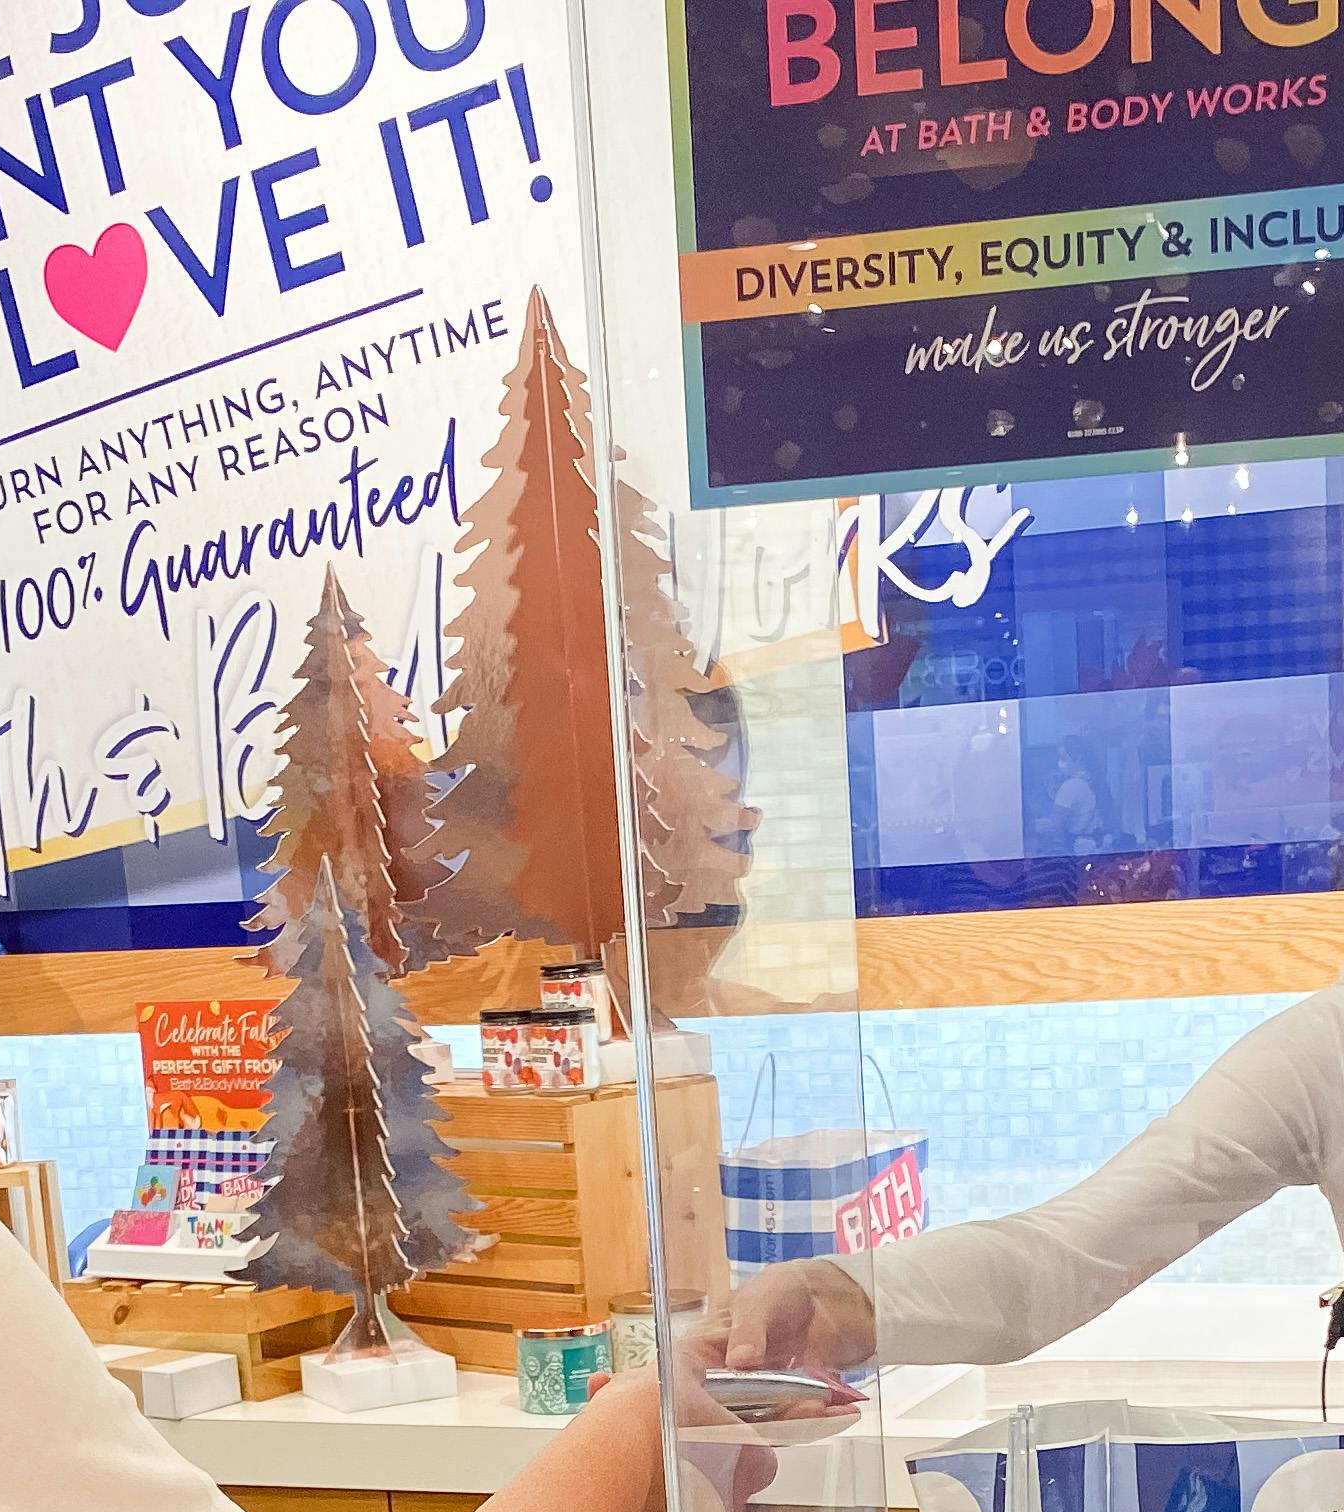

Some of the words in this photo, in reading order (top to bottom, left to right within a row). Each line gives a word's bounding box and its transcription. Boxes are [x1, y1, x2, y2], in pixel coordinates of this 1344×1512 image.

[165, 0, 485, 150] YOU
[860, 123, 906, 156] AT
[918, 111, 1012, 150] BATH
[1026, 107, 1050, 137] &
[1066, 92, 1173, 134] BODY
[1187, 74, 1328, 119] WORKS
[379, 64, 553, 248] IT!
[736, 245, 963, 301] DIVERSITY,
[981, 226, 1145, 277] EQUITY
[1161, 220, 1192, 257] &
[904, 305, 1029, 374] make
[1038, 321, 1094, 365] us
[1103, 289, 1289, 392] stronger
[78, 375, 299, 482] ANYTHING,
[315, 299, 509, 400] ANYTIME
[32, 492, 112, 544] FOR
[126, 455, 200, 515] ANY
[221, 393, 390, 482] REASON
[0, 553, 103, 653] 100%
[121, 417, 462, 642] Guaranteed
[152, 1060, 208, 1074] PERFECT
[212, 1060, 241, 1074] GIFT
[156, 1010, 238, 1047] Celebrate
[191, 1045, 218, 1056] WITH
[220, 1045, 241, 1056] THE
[187, 1216, 233, 1235] THANK
[197, 1236, 224, 1248] YOU
[842, 1161, 916, 1256] BATH
